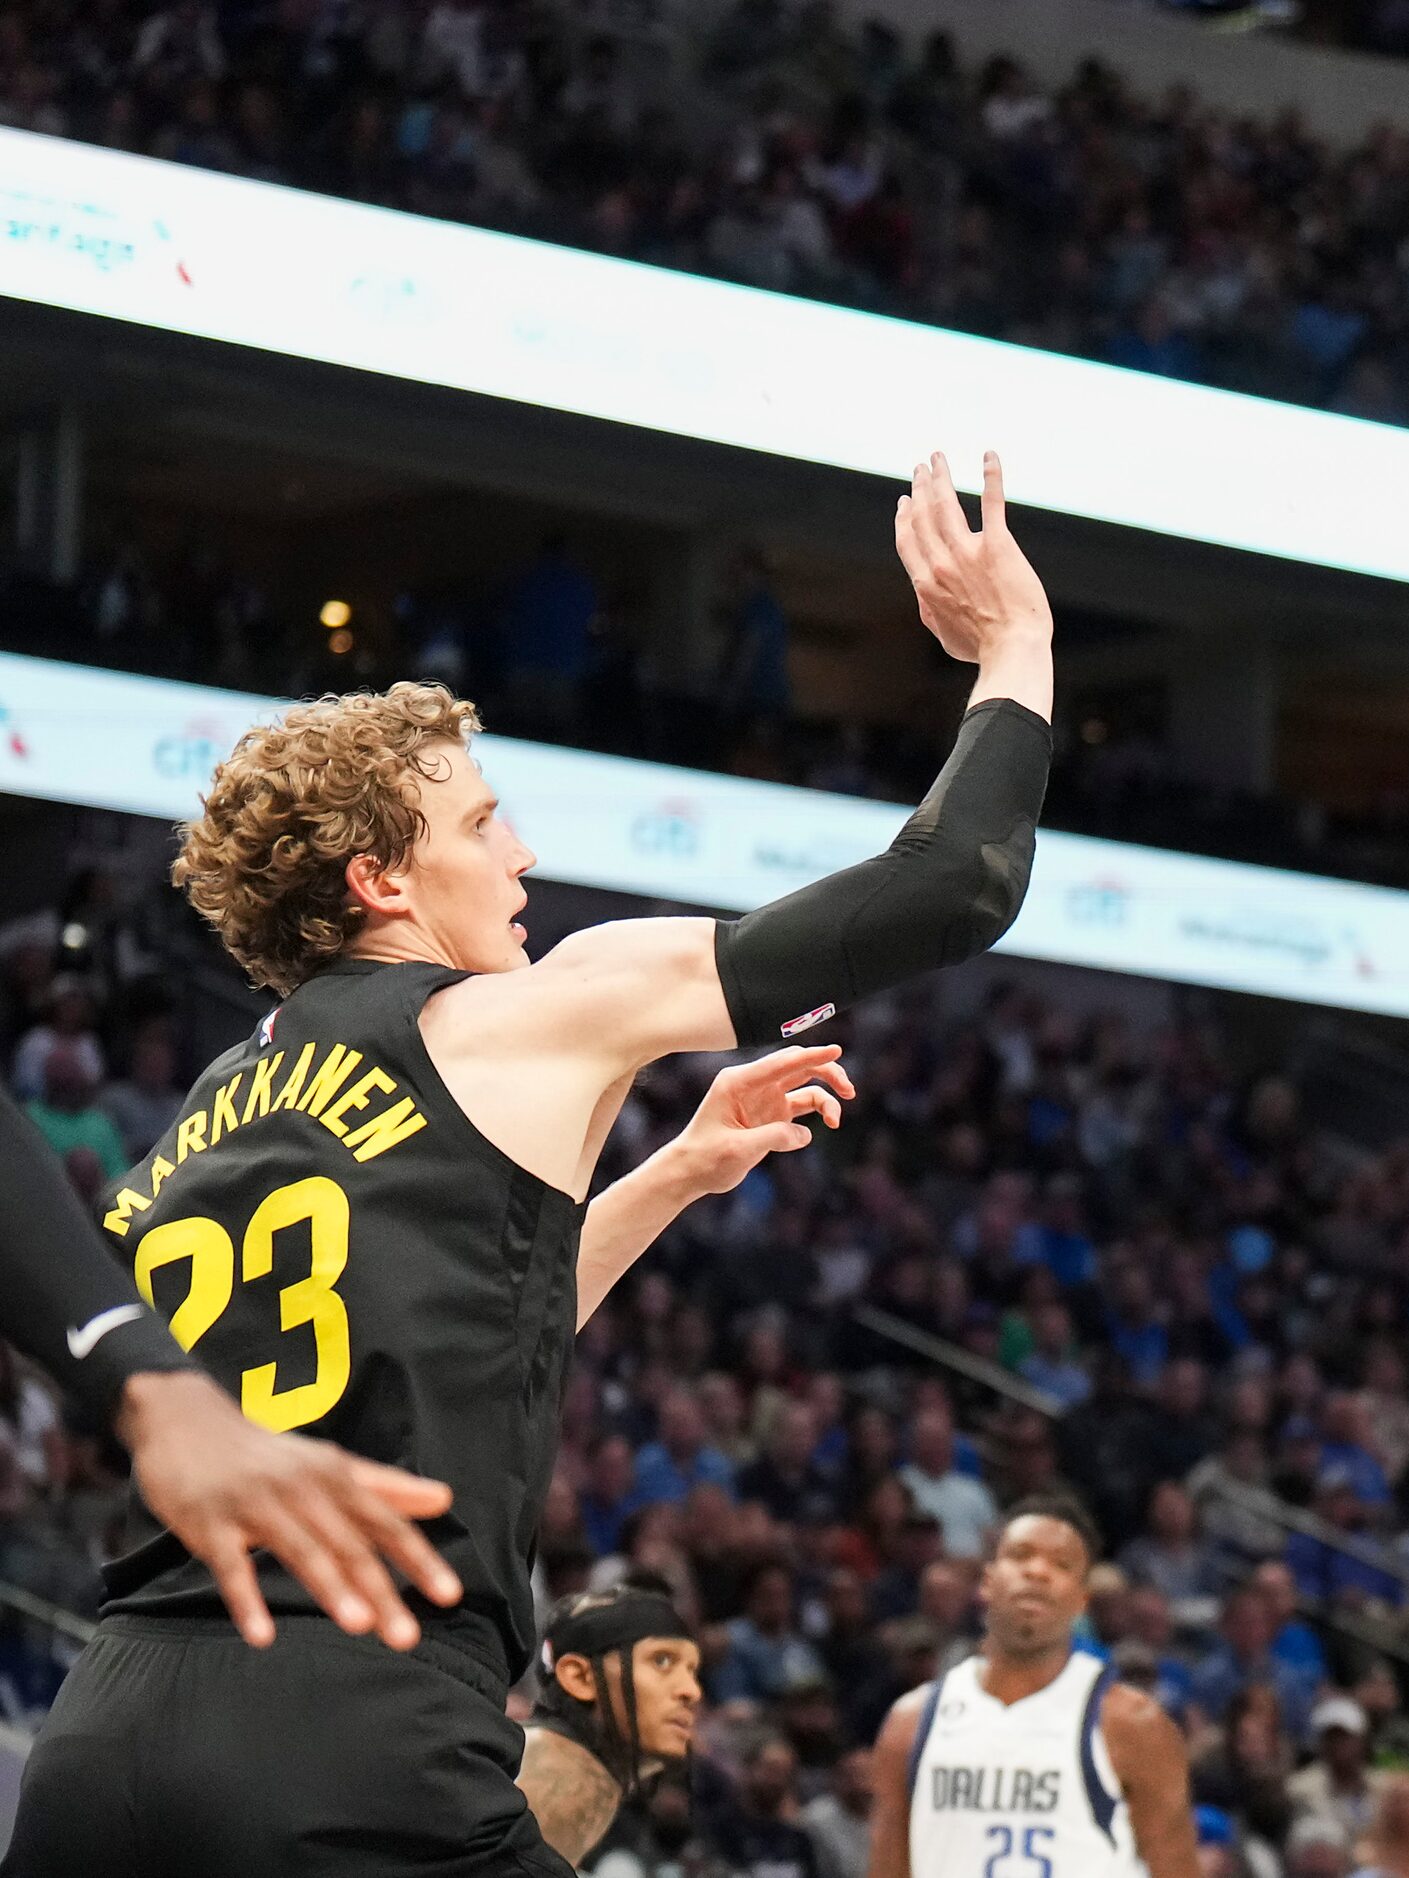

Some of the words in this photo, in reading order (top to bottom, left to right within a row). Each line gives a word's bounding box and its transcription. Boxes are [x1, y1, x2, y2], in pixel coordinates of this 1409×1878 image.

[102, 1041, 429, 1238] MARKKANEN
[134, 1175, 351, 1434] 23
[930, 1766, 1061, 1813] DALLAS
[985, 1824, 1057, 1878] 25
